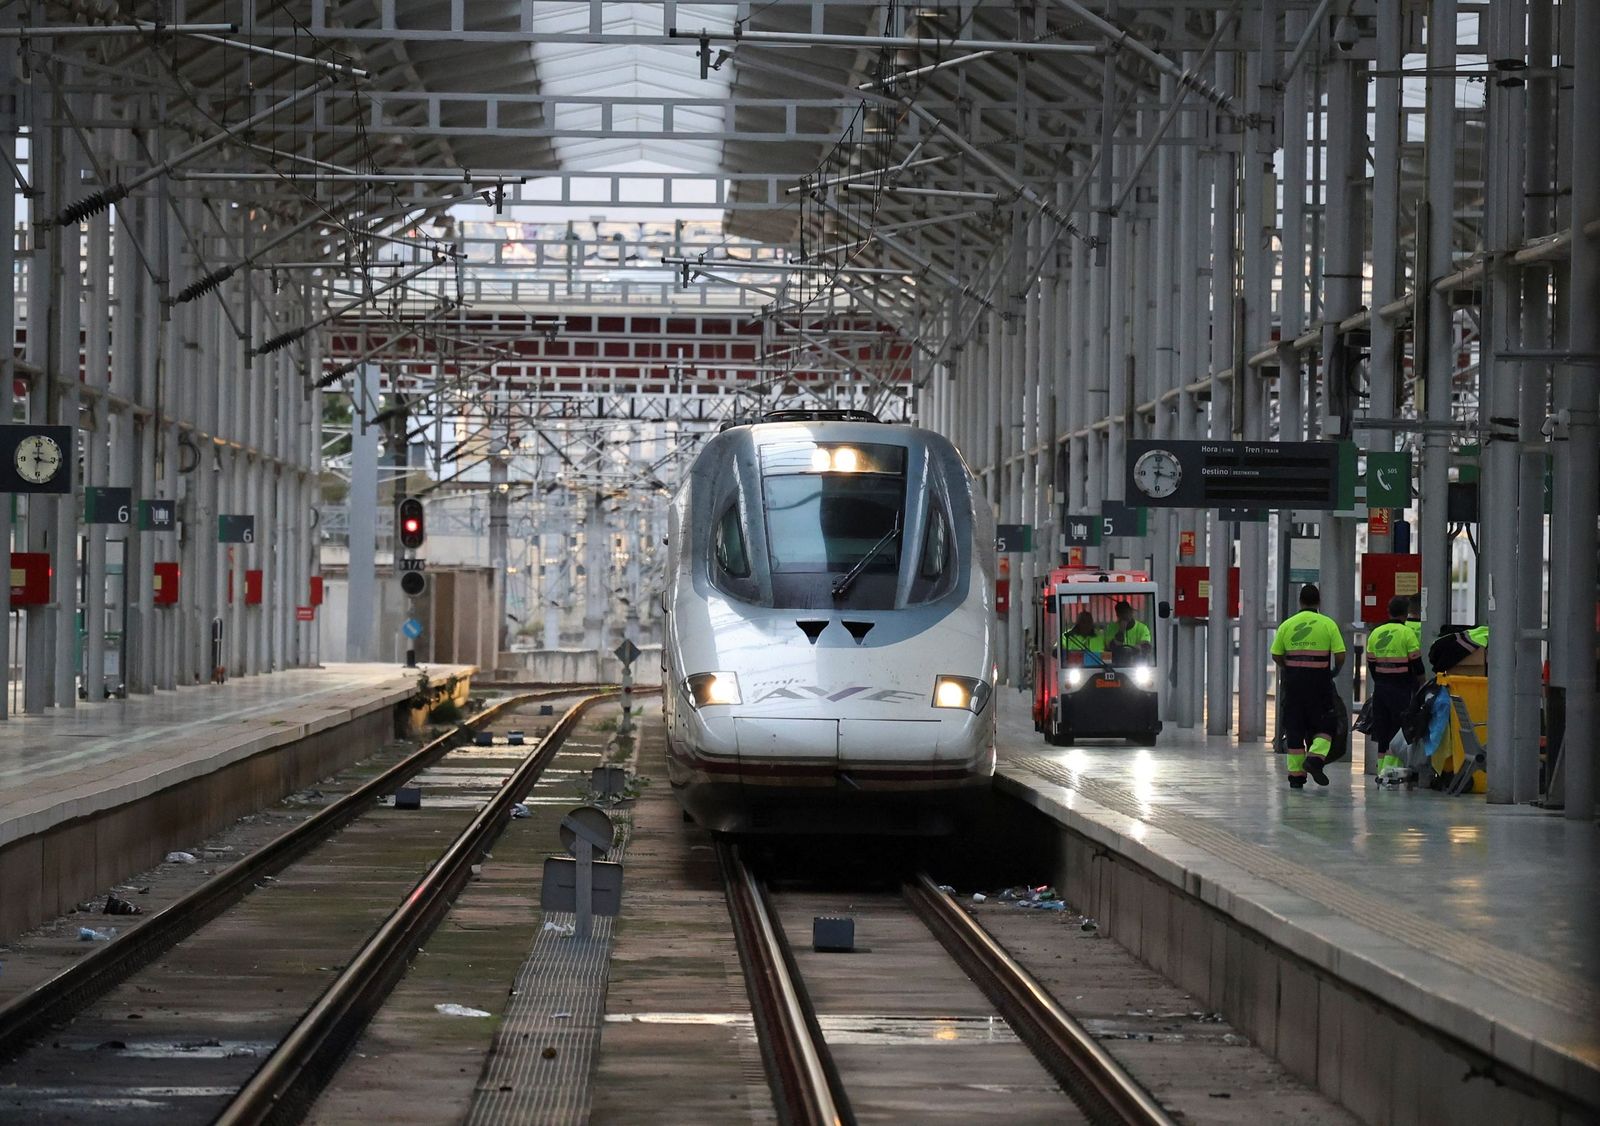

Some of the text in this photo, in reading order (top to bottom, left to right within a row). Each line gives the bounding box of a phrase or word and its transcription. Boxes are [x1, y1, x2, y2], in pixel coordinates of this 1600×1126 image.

[1201, 445, 1218, 453] Hora
[1201, 467, 1229, 475] Destino
[118, 505, 129, 523] 6
[1103, 517, 1114, 535] 5
[242, 528, 252, 543] 6
[997, 537, 1006, 551] 5
[753, 686, 926, 704] AVE
